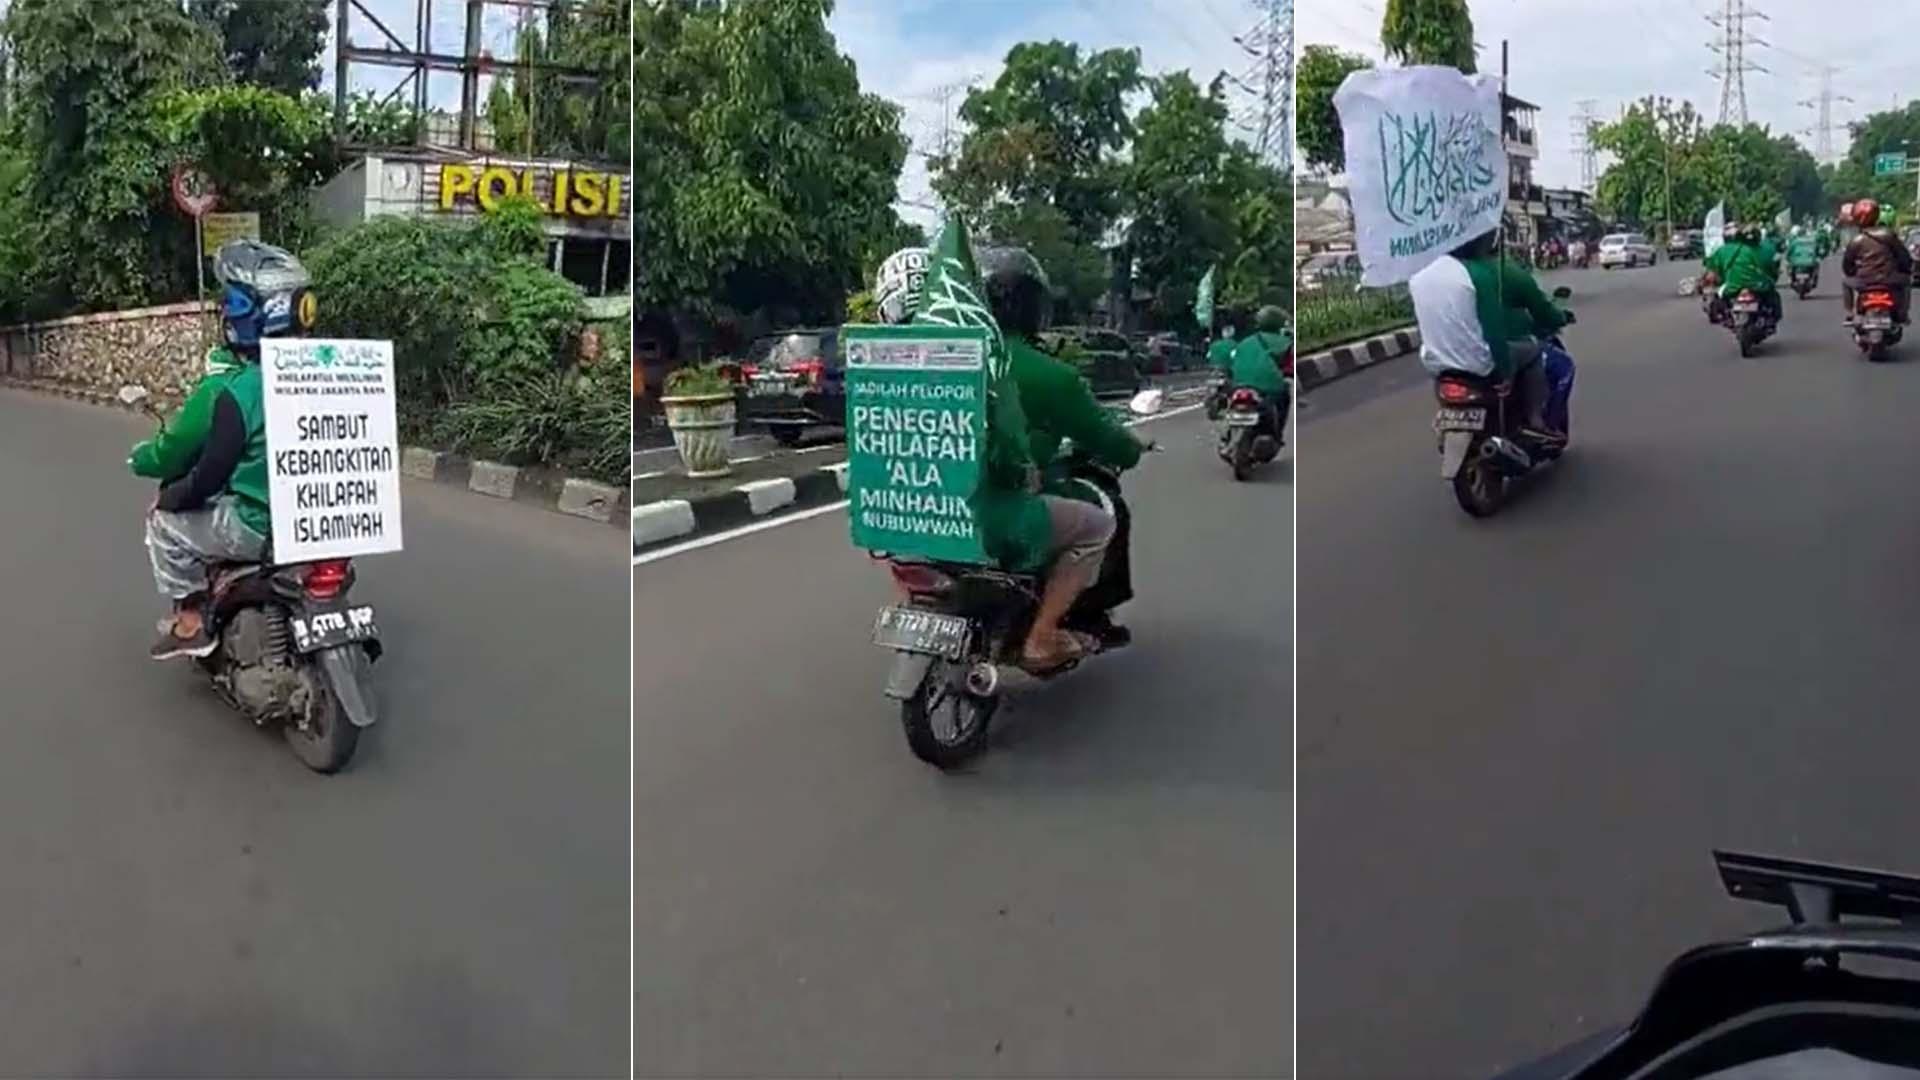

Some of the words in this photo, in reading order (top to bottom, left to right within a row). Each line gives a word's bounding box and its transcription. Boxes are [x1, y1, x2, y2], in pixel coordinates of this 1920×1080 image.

[297, 414, 369, 441] SAMBUT
[854, 406, 976, 436] PENEGAK
[275, 446, 392, 476] KEBANGKITAN
[855, 432, 977, 462] KHILAFAH
[296, 479, 378, 510] KHILAFAH
[860, 487, 972, 519] MINHAJIN
[294, 511, 384, 543] ISLAMIYAH
[862, 511, 974, 540] NUBUWWAH
